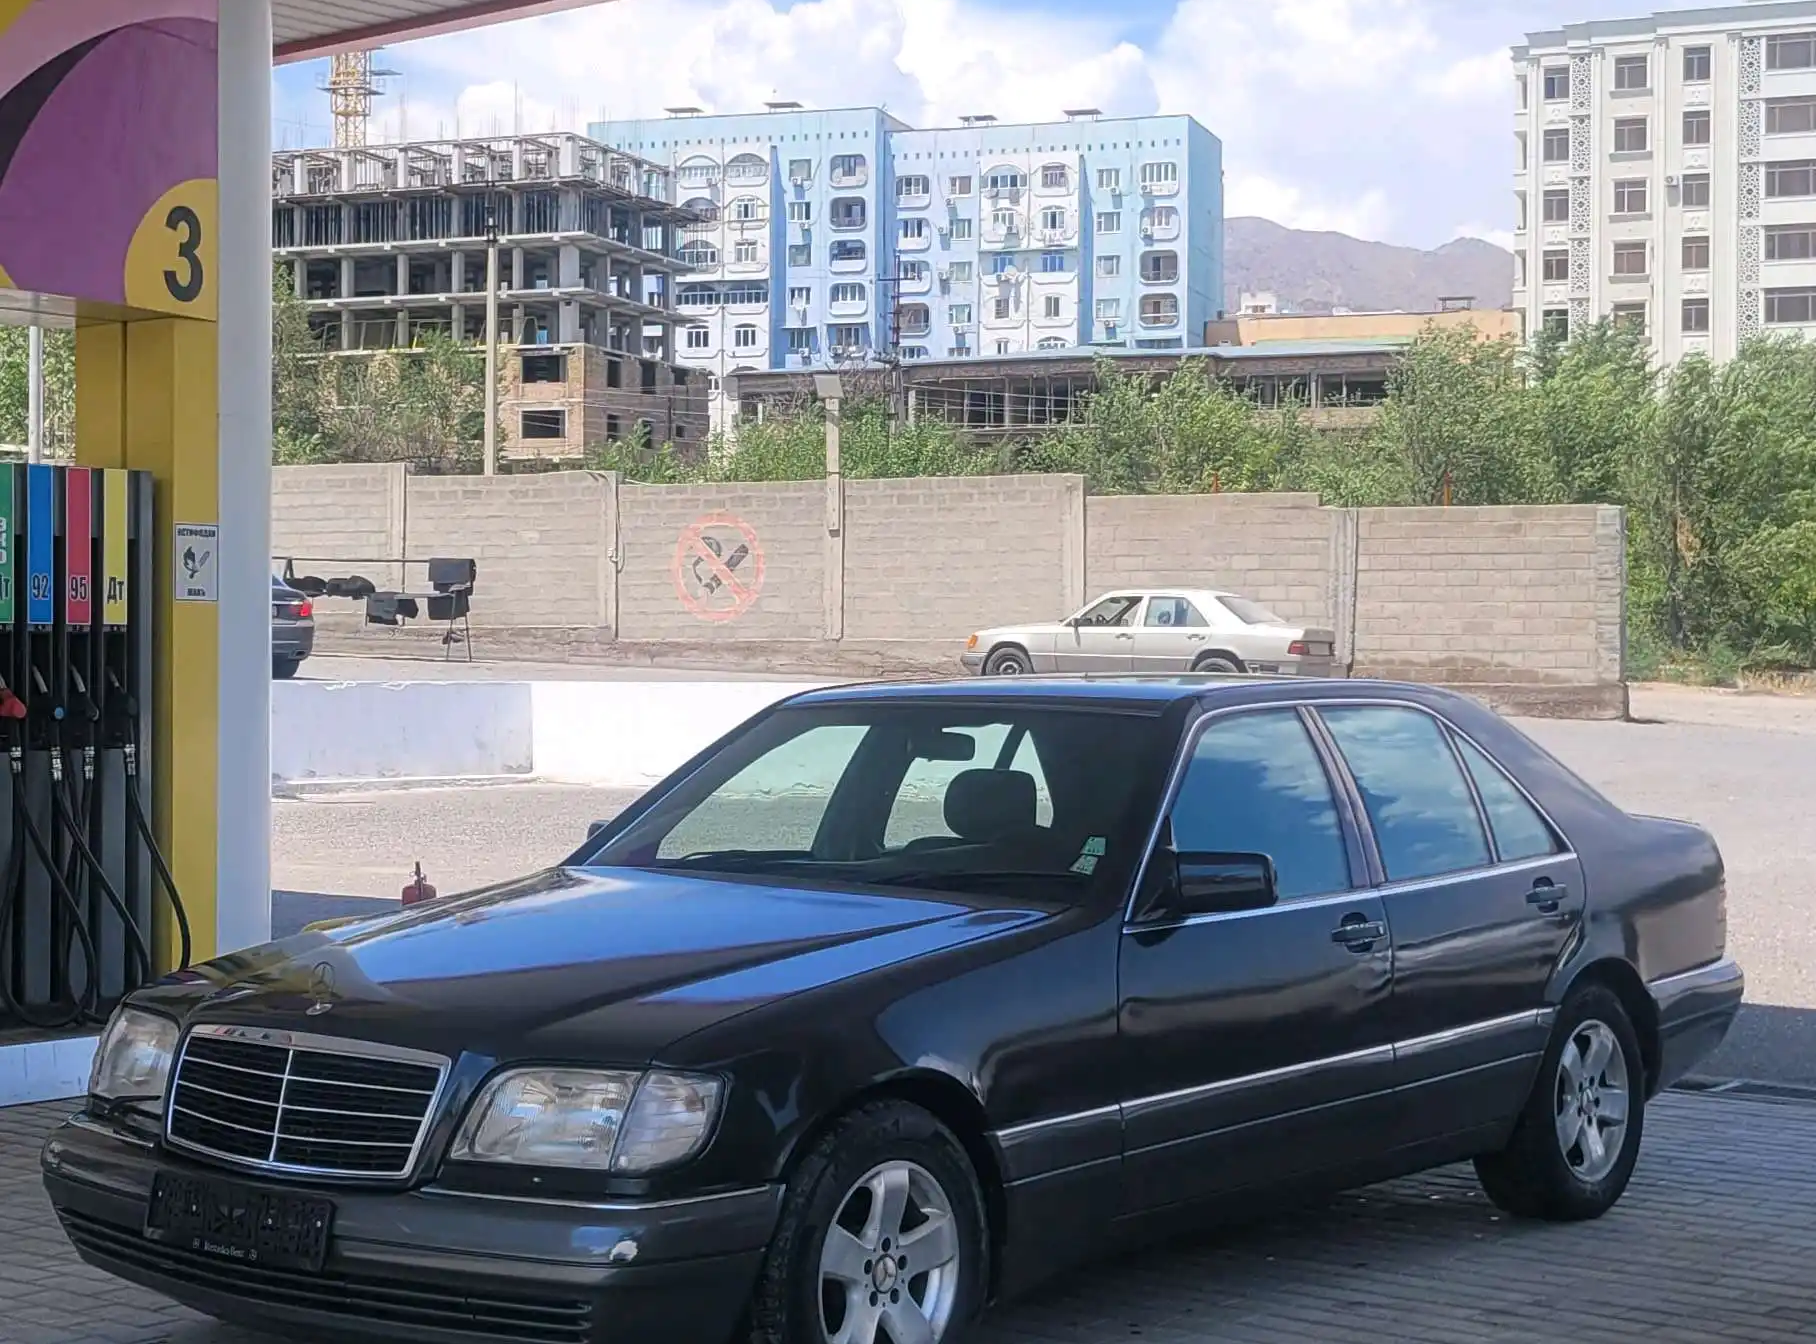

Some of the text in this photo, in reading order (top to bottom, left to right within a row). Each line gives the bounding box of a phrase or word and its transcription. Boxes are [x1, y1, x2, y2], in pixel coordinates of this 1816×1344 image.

[163, 205, 204, 302] 3
[32, 574, 49, 600] 92
[70, 576, 87, 601] 95
